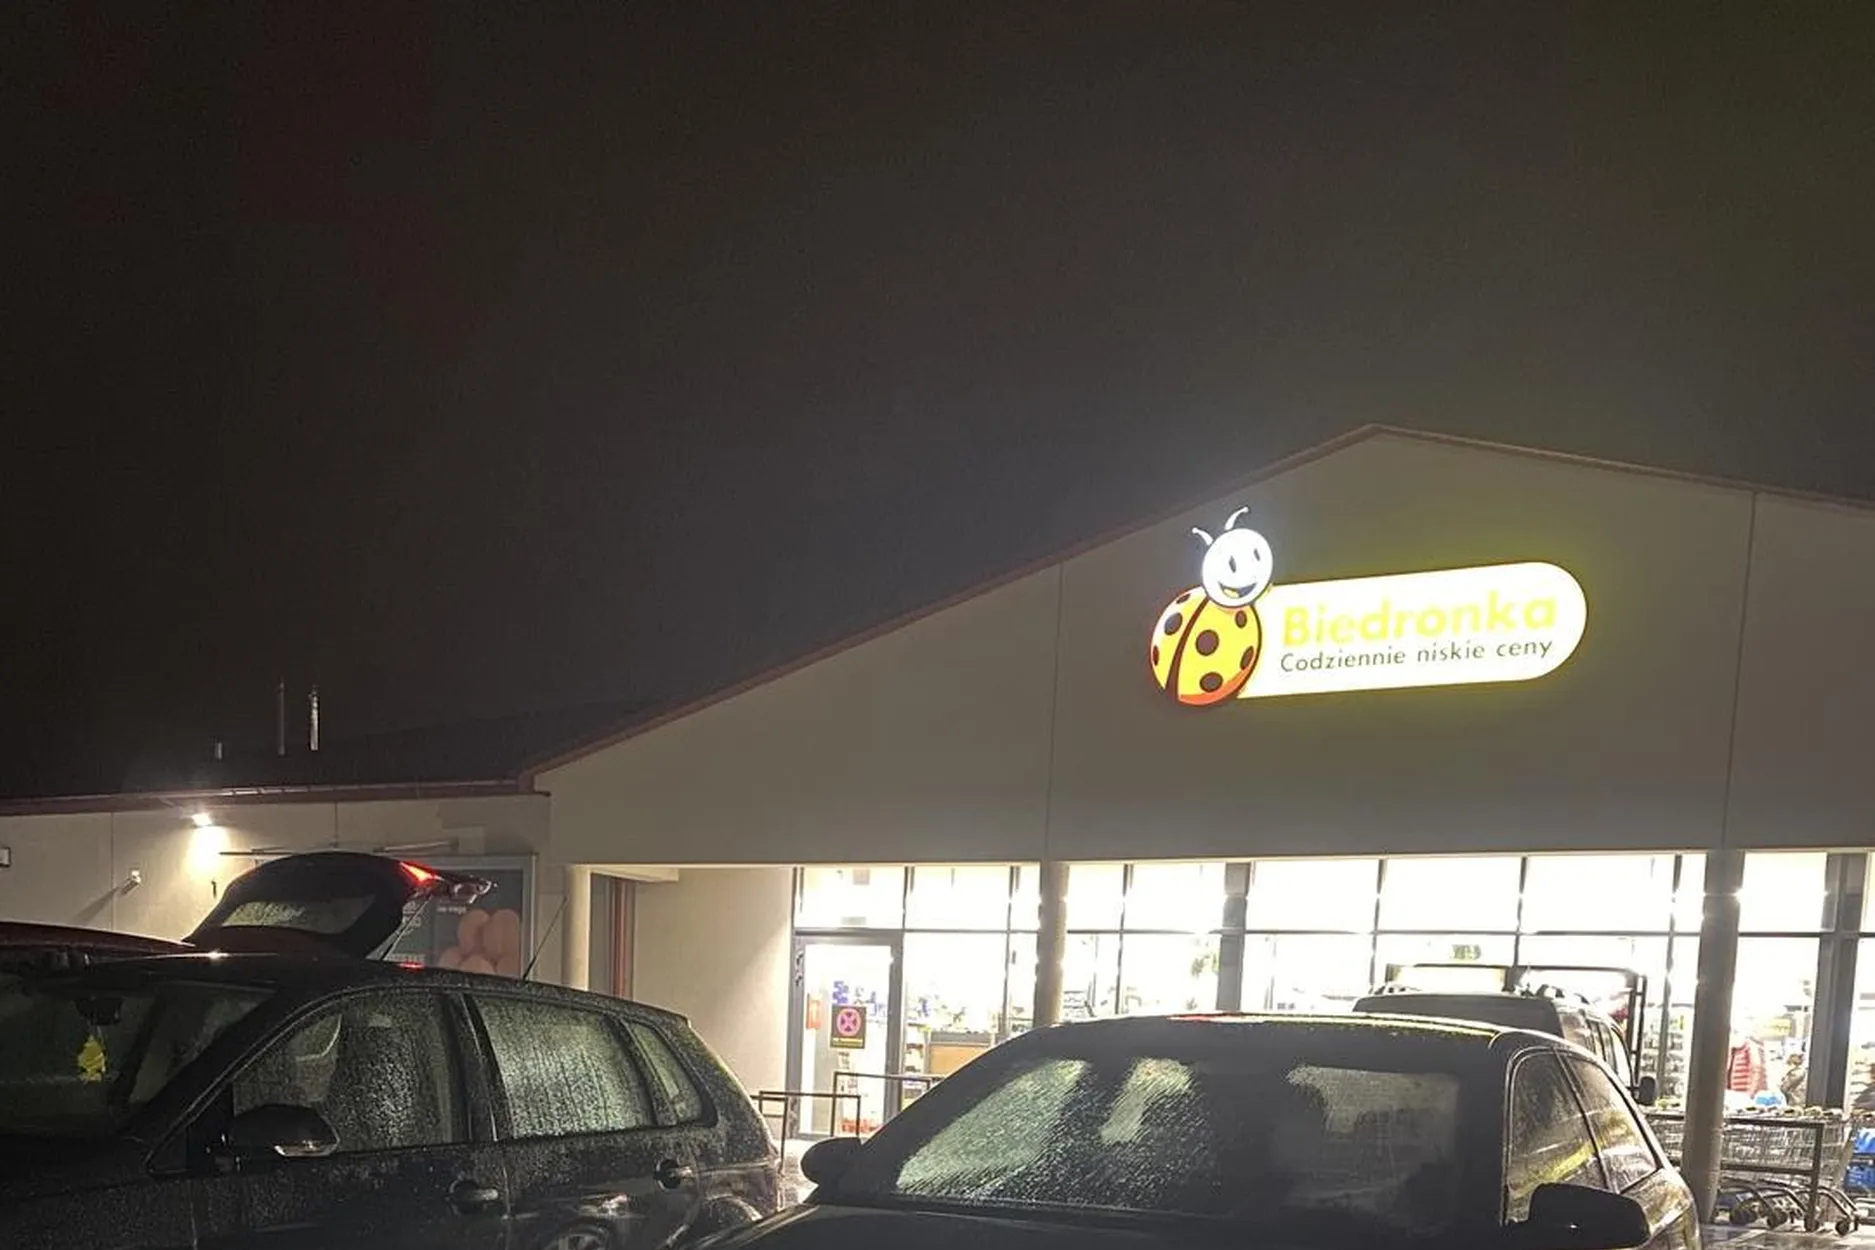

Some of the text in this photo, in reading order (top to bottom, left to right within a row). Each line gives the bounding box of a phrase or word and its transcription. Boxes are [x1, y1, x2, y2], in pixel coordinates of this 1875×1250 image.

[1283, 590, 1557, 647] Biedronka
[1280, 639, 1553, 673] Codziennie niskie ceny
